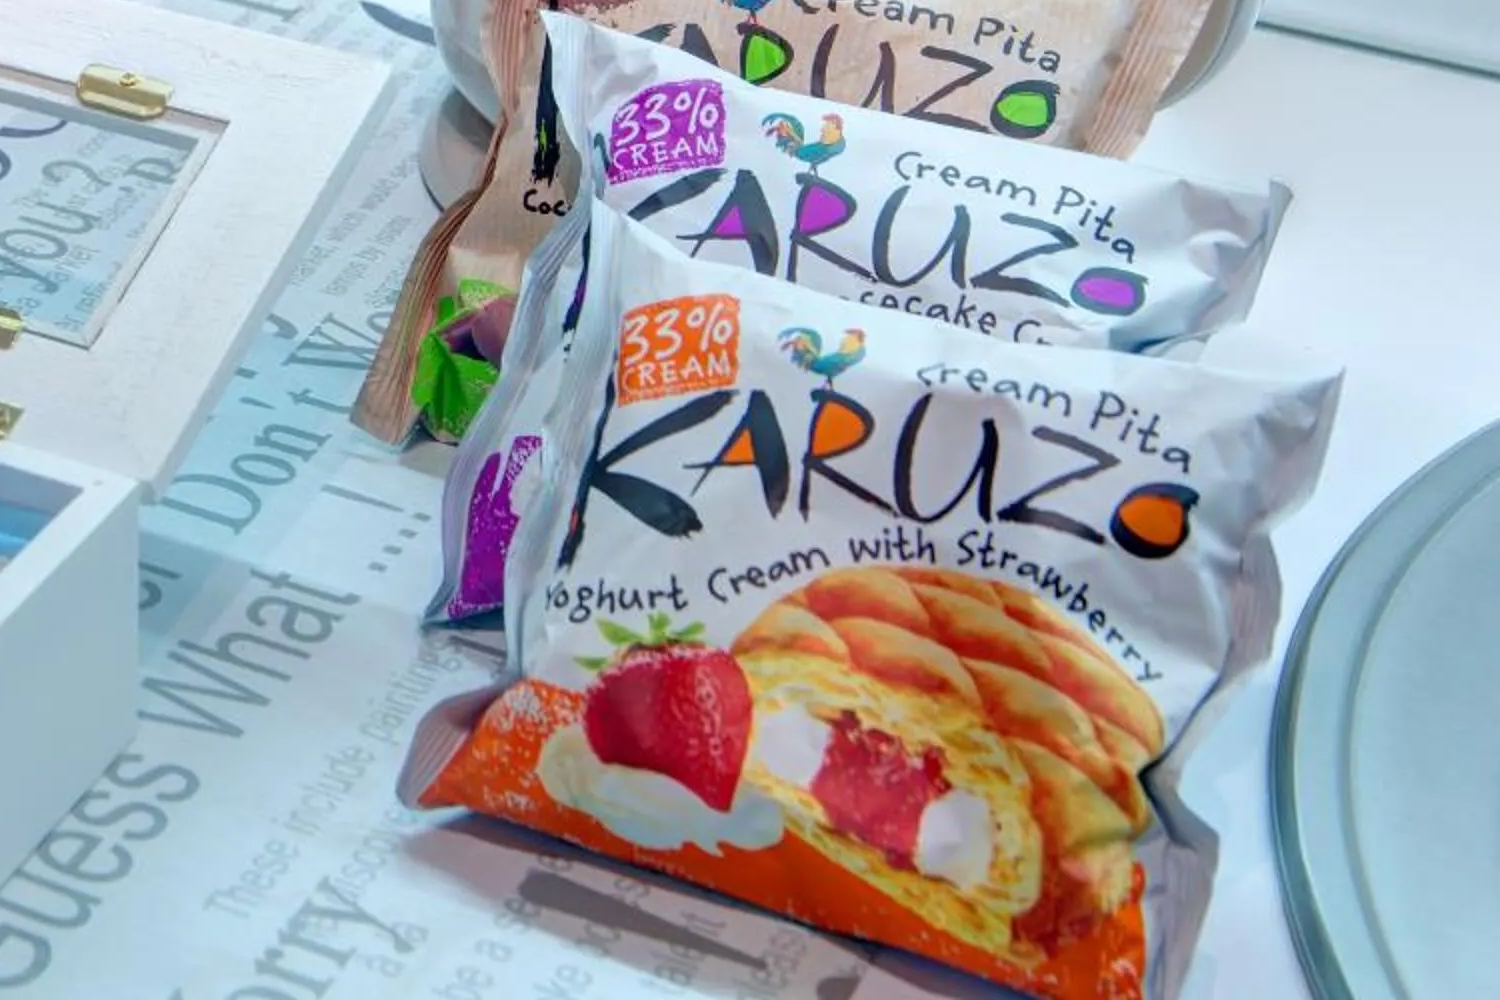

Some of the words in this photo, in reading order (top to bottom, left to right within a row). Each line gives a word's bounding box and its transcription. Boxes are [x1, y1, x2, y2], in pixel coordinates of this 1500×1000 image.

[973, 16, 1062, 74] Pita
[611, 135, 719, 171] CREAM
[614, 87, 720, 147] 33%
[893, 150, 1037, 206] Cream
[1053, 185, 1136, 264] Pita
[622, 349, 732, 393] CREAM
[623, 301, 733, 366] 33%
[160, 386, 352, 536] Don't
[916, 362, 1072, 418] Cream
[1090, 390, 1191, 473] Pita
[555, 380, 1200, 572] KARUZO
[136, 566, 361, 739] What
[707, 545, 831, 603] Cream
[848, 526, 937, 564] with
[956, 530, 1164, 684] Strawberry
[204, 834, 300, 922] These
